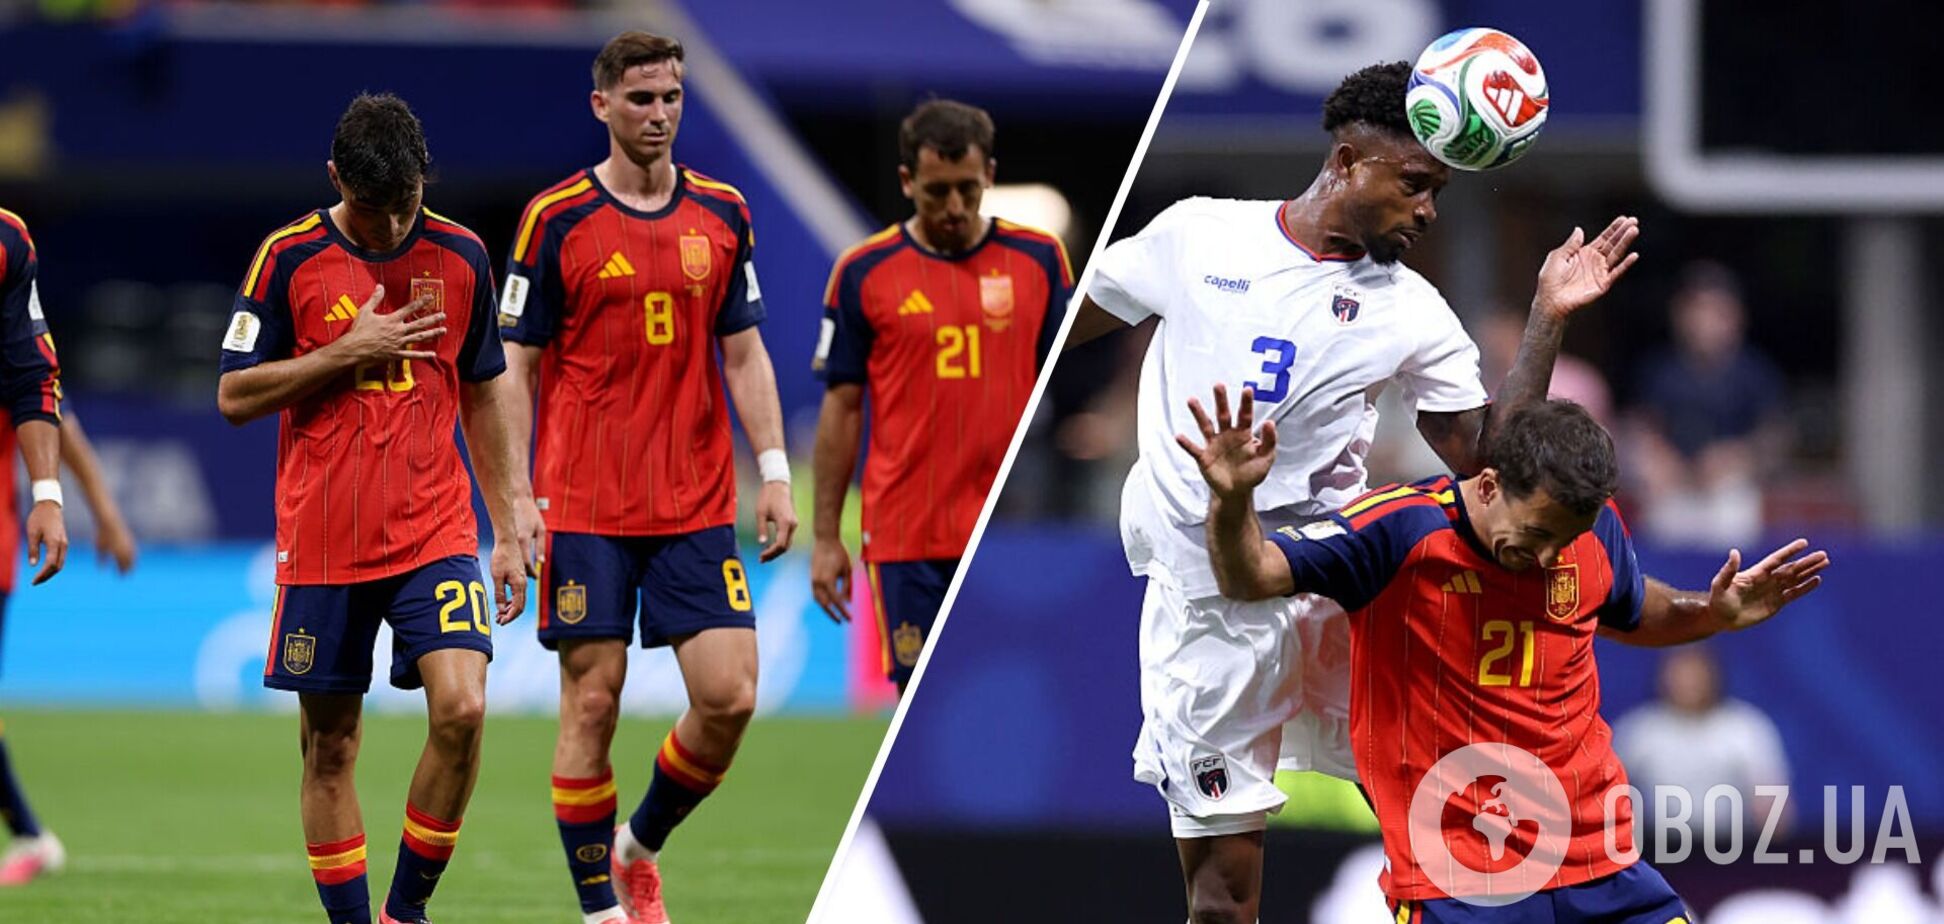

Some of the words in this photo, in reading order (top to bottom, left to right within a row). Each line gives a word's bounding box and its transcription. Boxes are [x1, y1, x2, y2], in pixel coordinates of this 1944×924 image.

[1204, 275, 1251, 292] capelli
[645, 291, 674, 345] 8
[936, 325, 980, 379] 21
[1243, 336, 1297, 403] 3
[435, 581, 490, 636] 20
[722, 559, 751, 611] 8
[1478, 621, 1534, 686] 21
[1194, 758, 1221, 771] FCF
